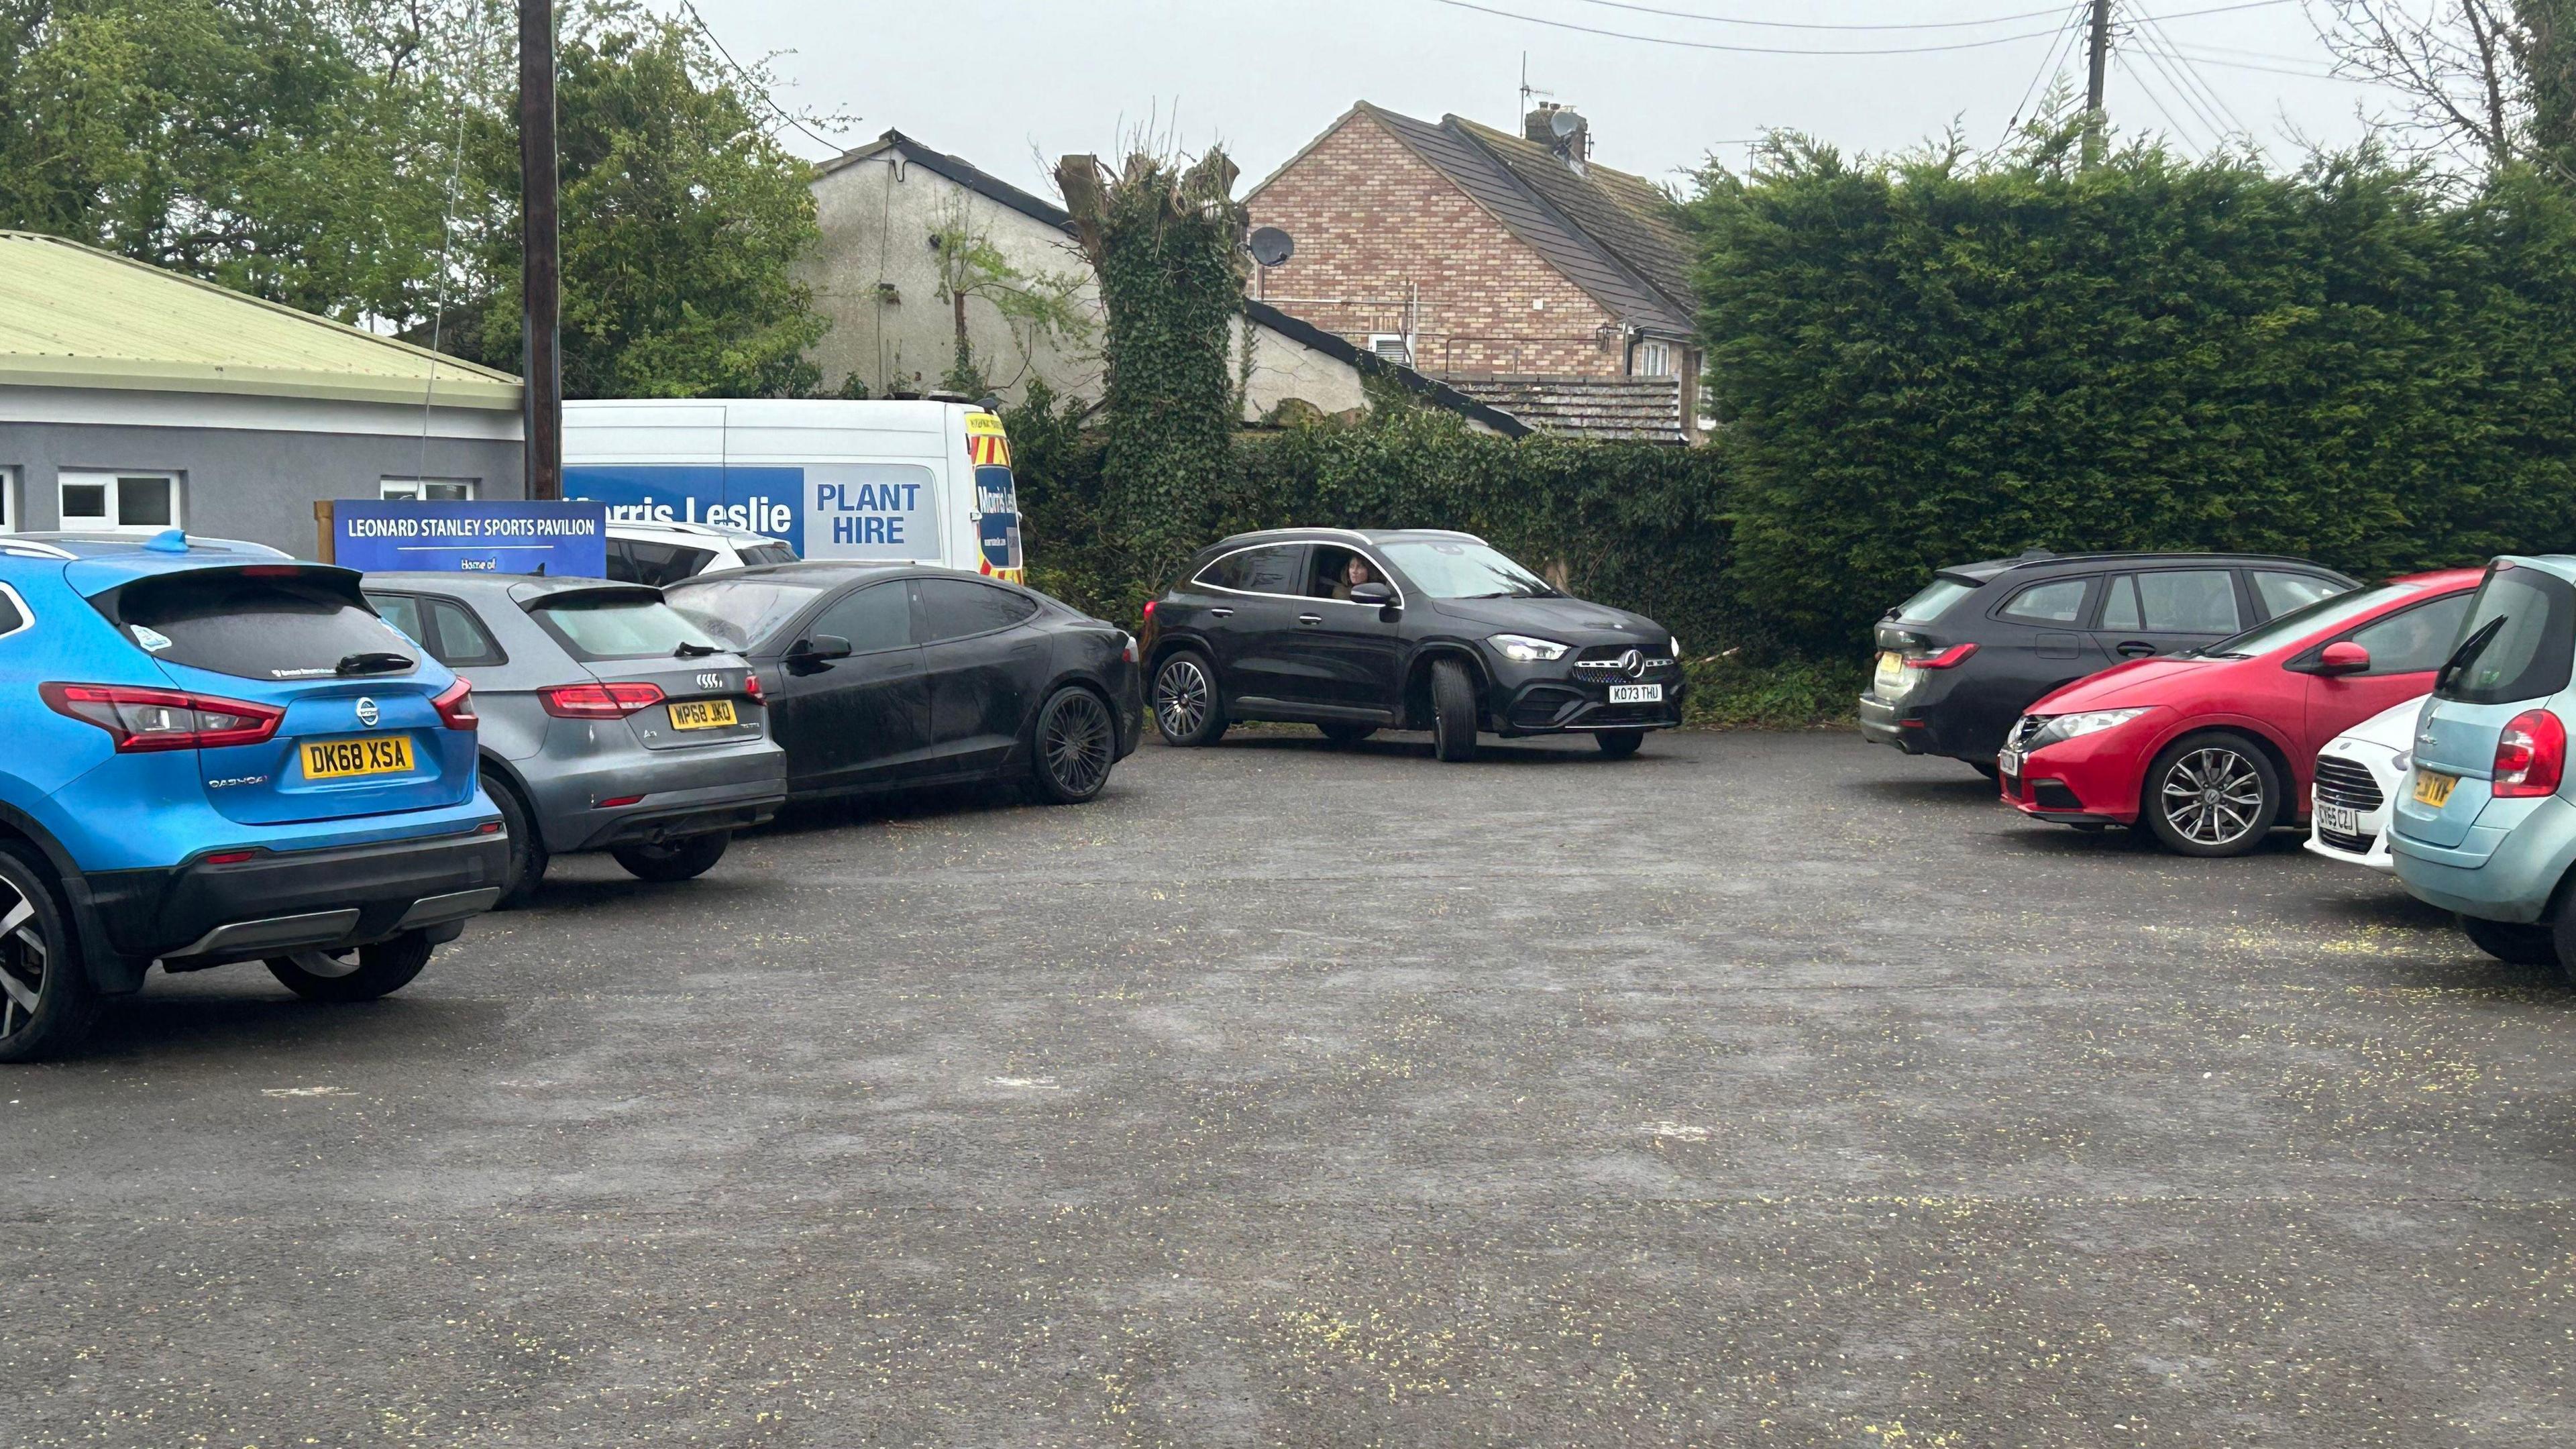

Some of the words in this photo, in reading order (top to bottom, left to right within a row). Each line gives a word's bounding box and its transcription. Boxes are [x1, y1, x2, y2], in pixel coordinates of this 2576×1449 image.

[817, 484, 920, 511] PLANT
[348, 519, 417, 537] LEONARD
[421, 519, 480, 537] STANLEY
[484, 519, 535, 535] SPORTS
[537, 519, 595, 535] PAVILION
[833, 517, 904, 544] HIRE
[1642, 686, 1658, 699] THU
[310, 743, 363, 773] DK68
[367, 740, 406, 769] XSA
